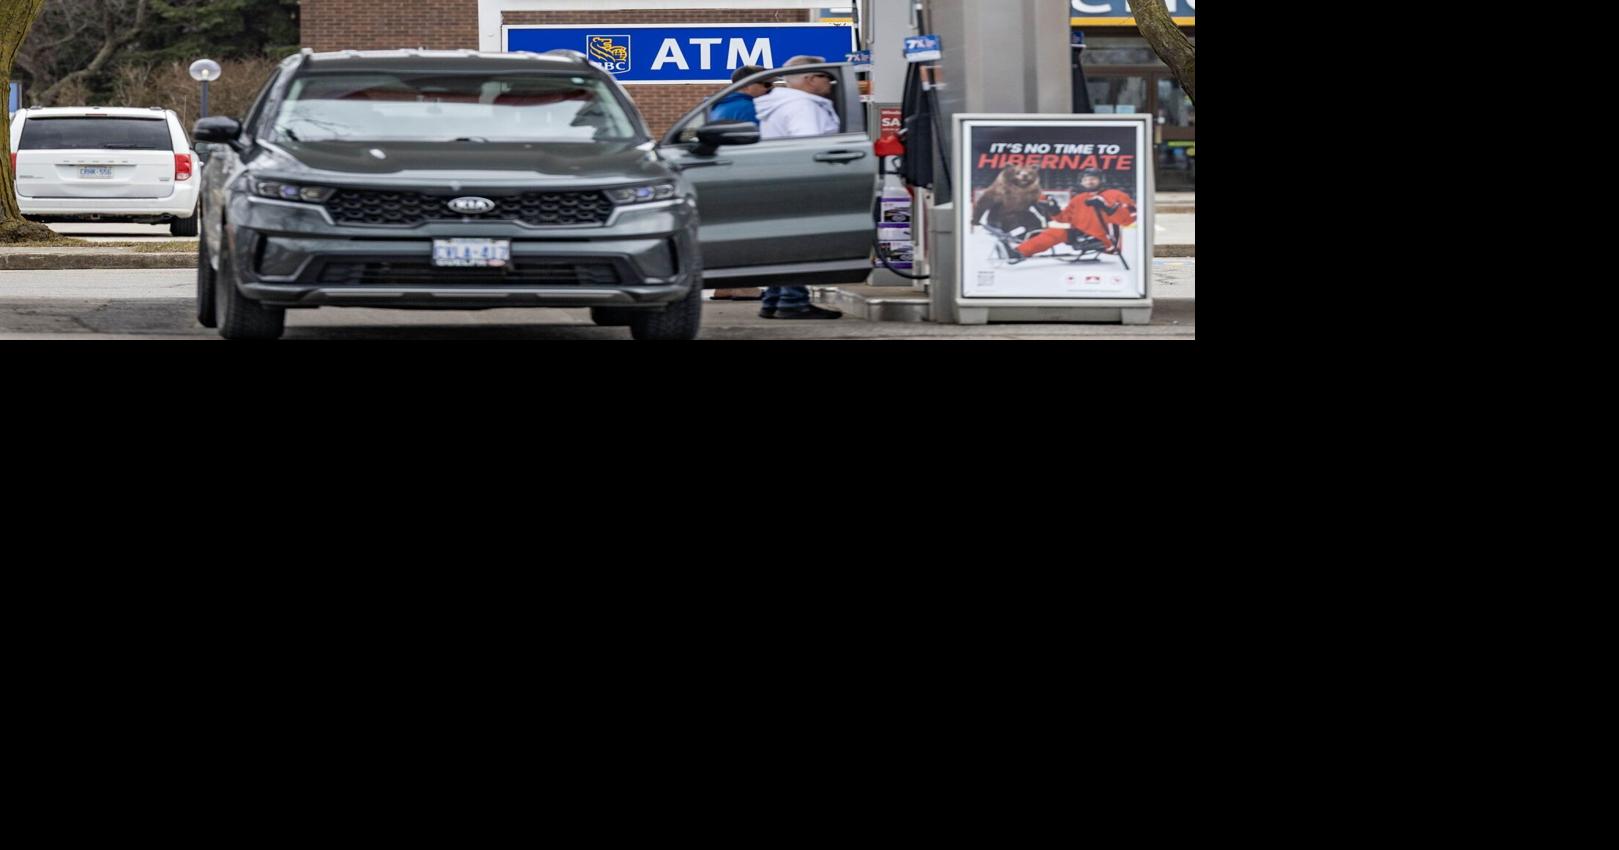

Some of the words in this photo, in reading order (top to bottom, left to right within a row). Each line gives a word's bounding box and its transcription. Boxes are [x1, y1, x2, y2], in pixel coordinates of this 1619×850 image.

[650, 37, 774, 70] ATM
[881, 117, 901, 127] SA
[989, 142, 1024, 154] IT'S
[1024, 143, 1051, 154] NO
[1053, 144, 1094, 154] TIME
[1097, 144, 1121, 155] TO
[977, 153, 1134, 170] HIBERNATE
